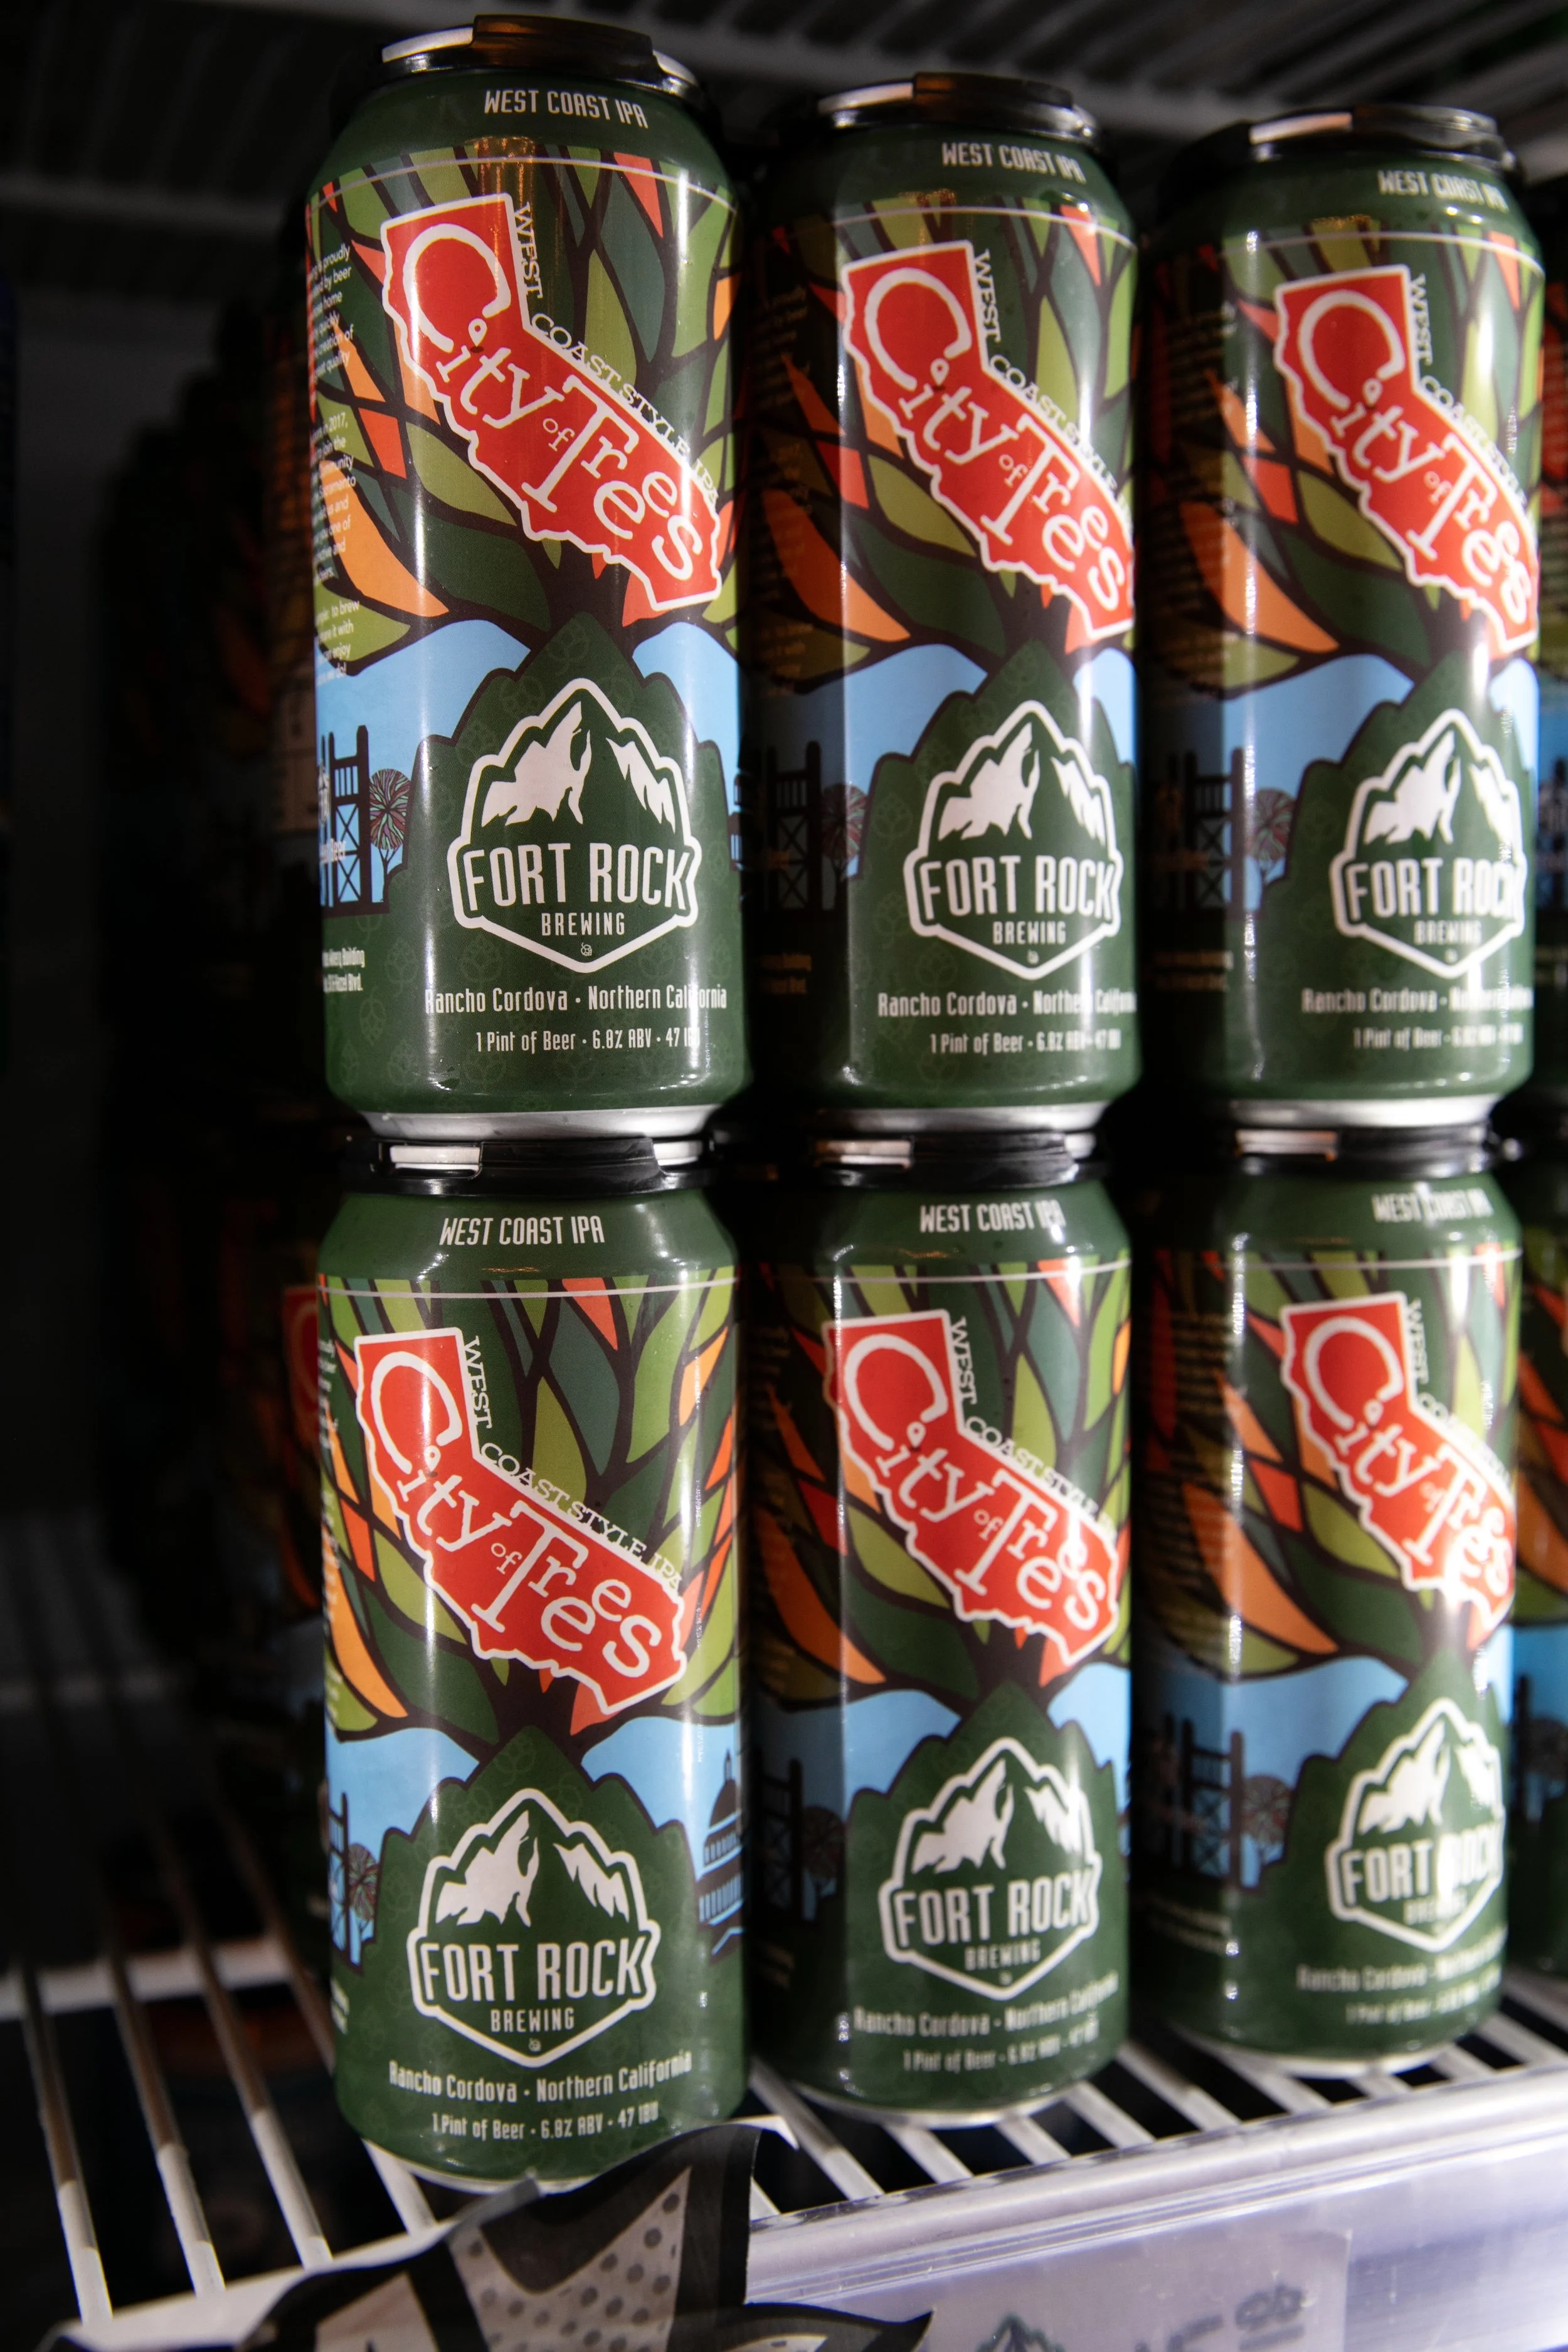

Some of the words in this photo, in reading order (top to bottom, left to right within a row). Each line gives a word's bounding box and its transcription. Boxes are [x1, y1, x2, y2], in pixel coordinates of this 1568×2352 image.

[484, 90, 539, 114] WEST
[547, 91, 610, 120] COAST
[615, 99, 649, 129] IPA
[941, 142, 993, 167] WEST
[998, 144, 1057, 176] COAST
[1377, 170, 1429, 196] WEST
[323, 243, 351, 272] proudly
[333, 266, 352, 283] beer
[344, 323, 354, 340] of
[403, 223, 564, 428] City
[513, 201, 543, 299] WEST
[531, 313, 621, 388] COAST
[620, 383, 691, 460] STYLE
[691, 459, 719, 509] IPA
[864, 267, 1019, 467] City
[974, 248, 1002, 342] WEST
[988, 353, 1067, 426] COAST
[1066, 420, 1118, 494] SYLE
[1298, 289, 1448, 482] City
[329, 411, 348, 433] 2017,
[543, 418, 575, 452] of
[334, 435, 346, 449] the
[522, 373, 702, 580] Trees
[999, 454, 1029, 488] of
[342, 514, 351, 530] of
[981, 413, 1125, 611] Trees
[339, 600, 359, 615] brew
[338, 618, 354, 635] with
[463, 843, 571, 911] FORT
[589, 843, 689, 910] ROCK
[920, 856, 1021, 921] FORT
[1036, 855, 1115, 919] ROCK
[1345, 857, 1443, 921] FORT
[541, 912, 625, 937] BREWING
[993, 921, 1066, 945] BREWING
[425, 988, 486, 1014] Rancho
[493, 987, 568, 1012] Cordova
[588, 985, 661, 1010] Northern
[666, 984, 727, 1009] Calornia
[878, 992, 941, 1017] Rancho
[946, 990, 1017, 1016] Cordova
[1033, 989, 1091, 1015] Northe
[477, 1032, 482, 1052] 1
[487, 1031, 515, 1052] Pint
[521, 1030, 538, 1054] of
[543, 1030, 576, 1051] Beer
[593, 1029, 623, 1049] 6.8%
[628, 1028, 652, 1048] ABV
[665, 1027, 681, 1047] 47
[930, 1034, 936, 1054] 1
[941, 1033, 968, 1054] Pint
[973, 1032, 989, 1056] of
[993, 1032, 1023, 1053] Beer
[439, 1217, 494, 1246] WEST
[499, 1216, 563, 1245] COAST
[571, 1216, 605, 1244] IPA
[920, 1204, 970, 1232] WEST
[976, 1202, 1035, 1231] COAST
[951, 1316, 977, 1404] WEST
[965, 1416, 1044, 1475] COAST
[1304, 1317, 1439, 1496] City
[844, 1333, 994, 1523] City
[373, 1350, 515, 1551] City
[463, 1335, 492, 1429] WEST
[480, 1443, 569, 1510] COAST
[567, 1500, 647, 1562] STYLE
[647, 1550, 683, 1593] IPA
[973, 1509, 1003, 1541] of
[491, 1542, 522, 1575] of
[955, 1468, 1105, 1631] Trees
[472, 1498, 663, 1677] Trees
[1341, 1840, 1433, 1905] FORT
[894, 1884, 994, 1947] FORT
[1008, 1867, 1093, 1936] ROCK
[419, 1943, 519, 2002] FORT
[537, 1936, 646, 2000] ROCK
[490, 2008, 575, 2033] BREWING
[389, 2060, 442, 2096] Rancho
[447, 2074, 517, 2102] Cordova
[536, 2074, 613, 2102] Northern
[618, 2049, 692, 2092] California
[432, 2111, 438, 2132] 1
[442, 2113, 467, 2136] Pint
[472, 2118, 488, 2141] of
[492, 2119, 526, 2139] Beer
[541, 2118, 573, 2139] 6.8%
[578, 2113, 603, 2136] ABV
[618, 2106, 635, 2128] 47
[638, 2102, 658, 2124] IBU
